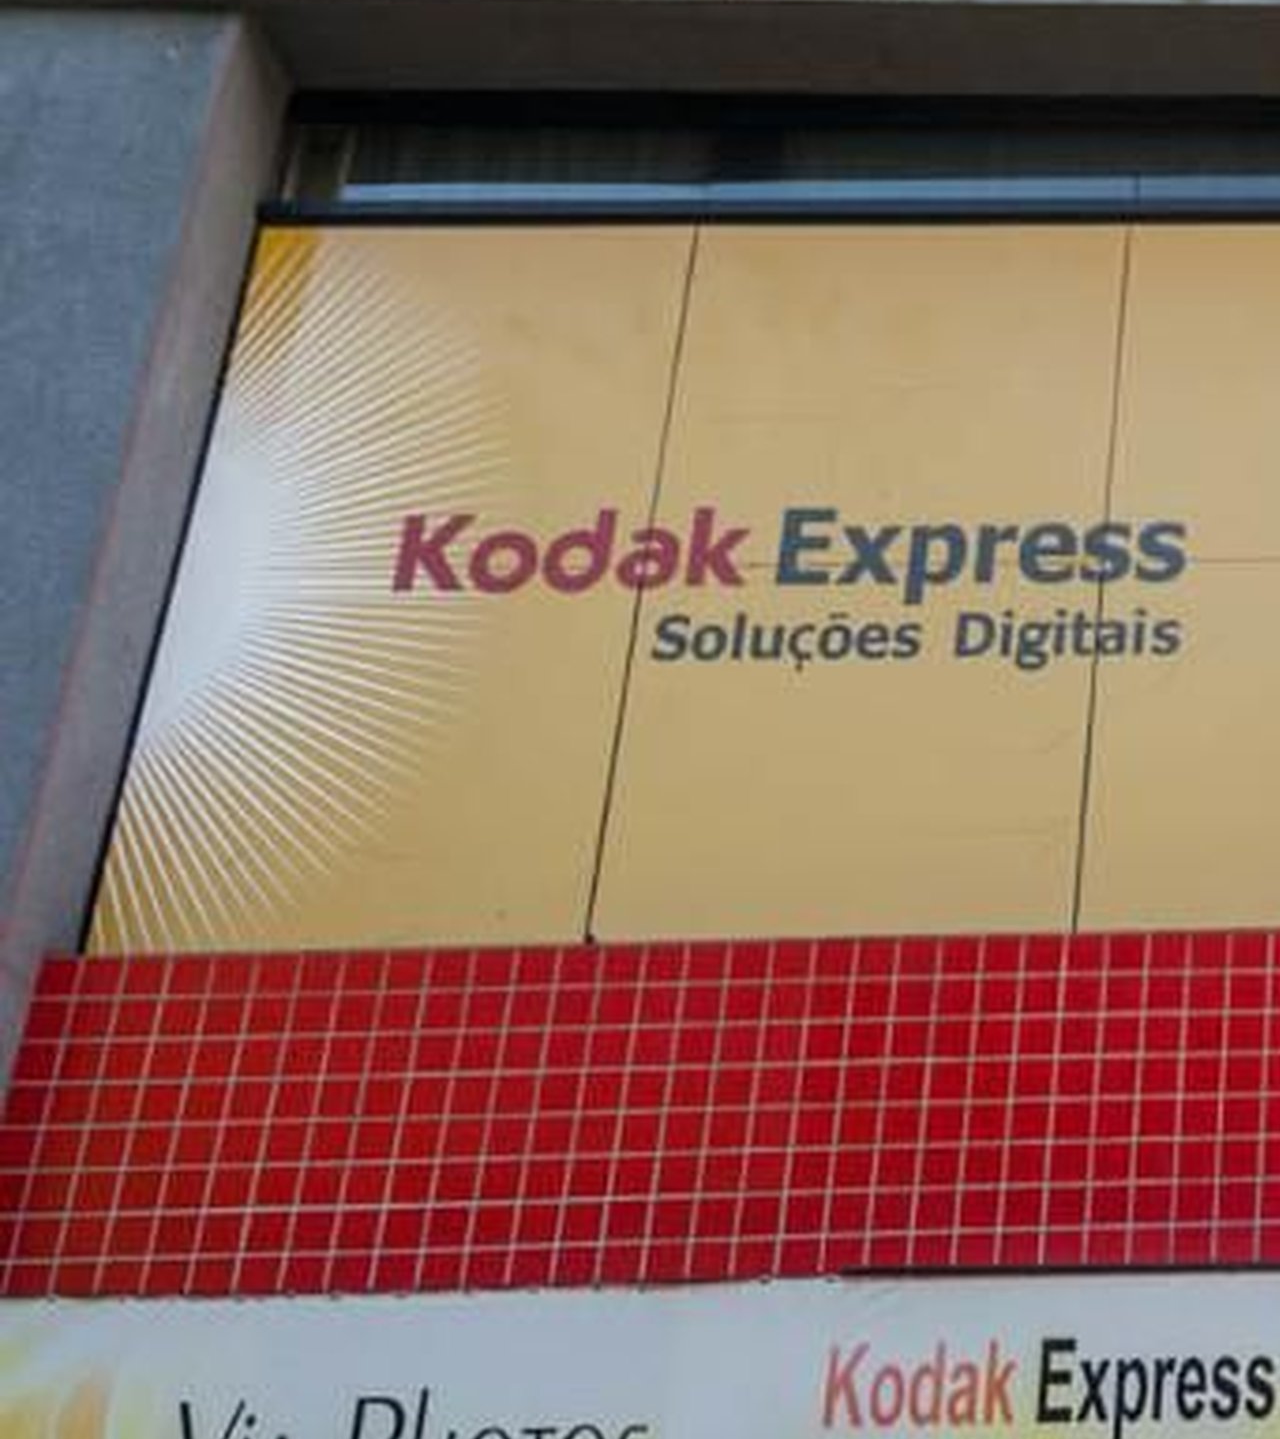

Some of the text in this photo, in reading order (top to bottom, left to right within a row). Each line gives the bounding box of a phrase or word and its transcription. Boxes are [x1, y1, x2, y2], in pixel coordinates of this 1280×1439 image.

[391, 506, 1190, 606] Kodak Express
[650, 609, 1183, 672] Soluções Digitais
[821, 1338, 1020, 1429] Kodak
